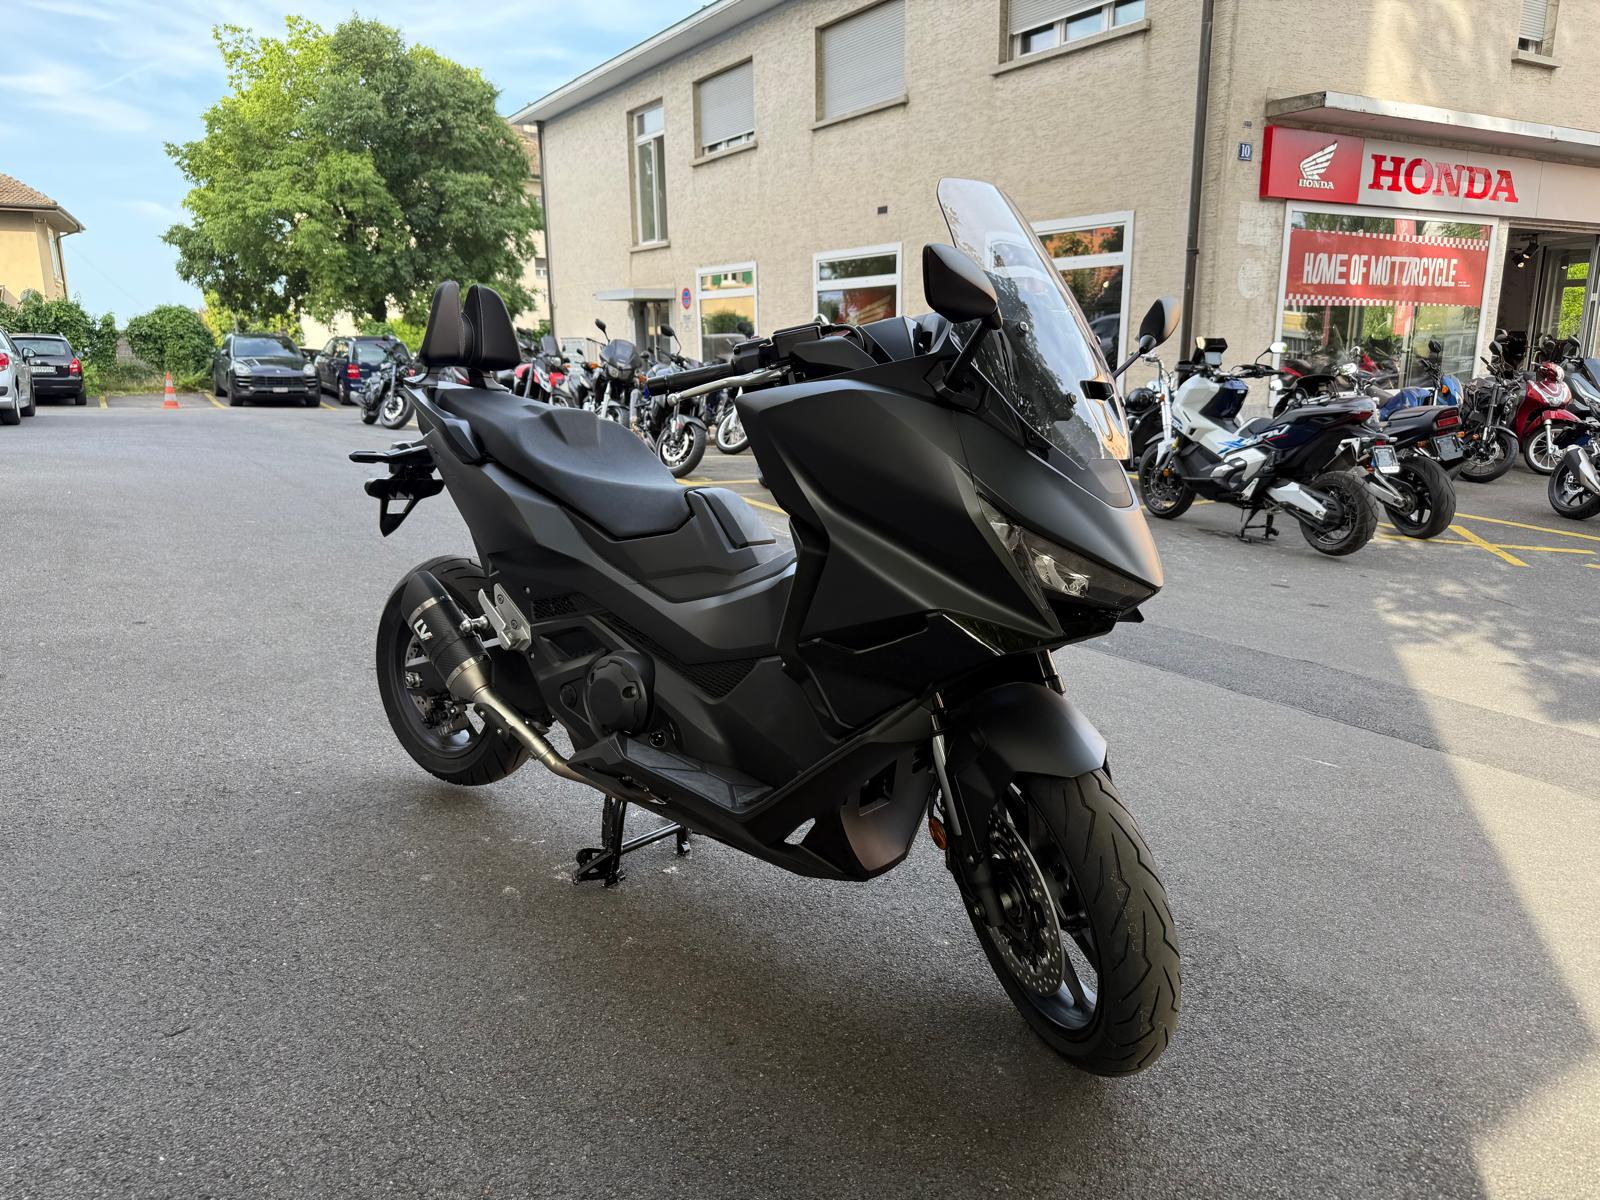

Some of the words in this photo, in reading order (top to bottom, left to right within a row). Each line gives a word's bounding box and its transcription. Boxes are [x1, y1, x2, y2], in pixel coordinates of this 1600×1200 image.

[1240, 144, 1251, 158] 10
[1298, 178, 1335, 190] HONDA
[1368, 153, 1519, 204] HONDA
[1302, 252, 1349, 285] HOME
[1350, 254, 1369, 286] OF
[1368, 255, 1459, 288] MOTORCYCLE
